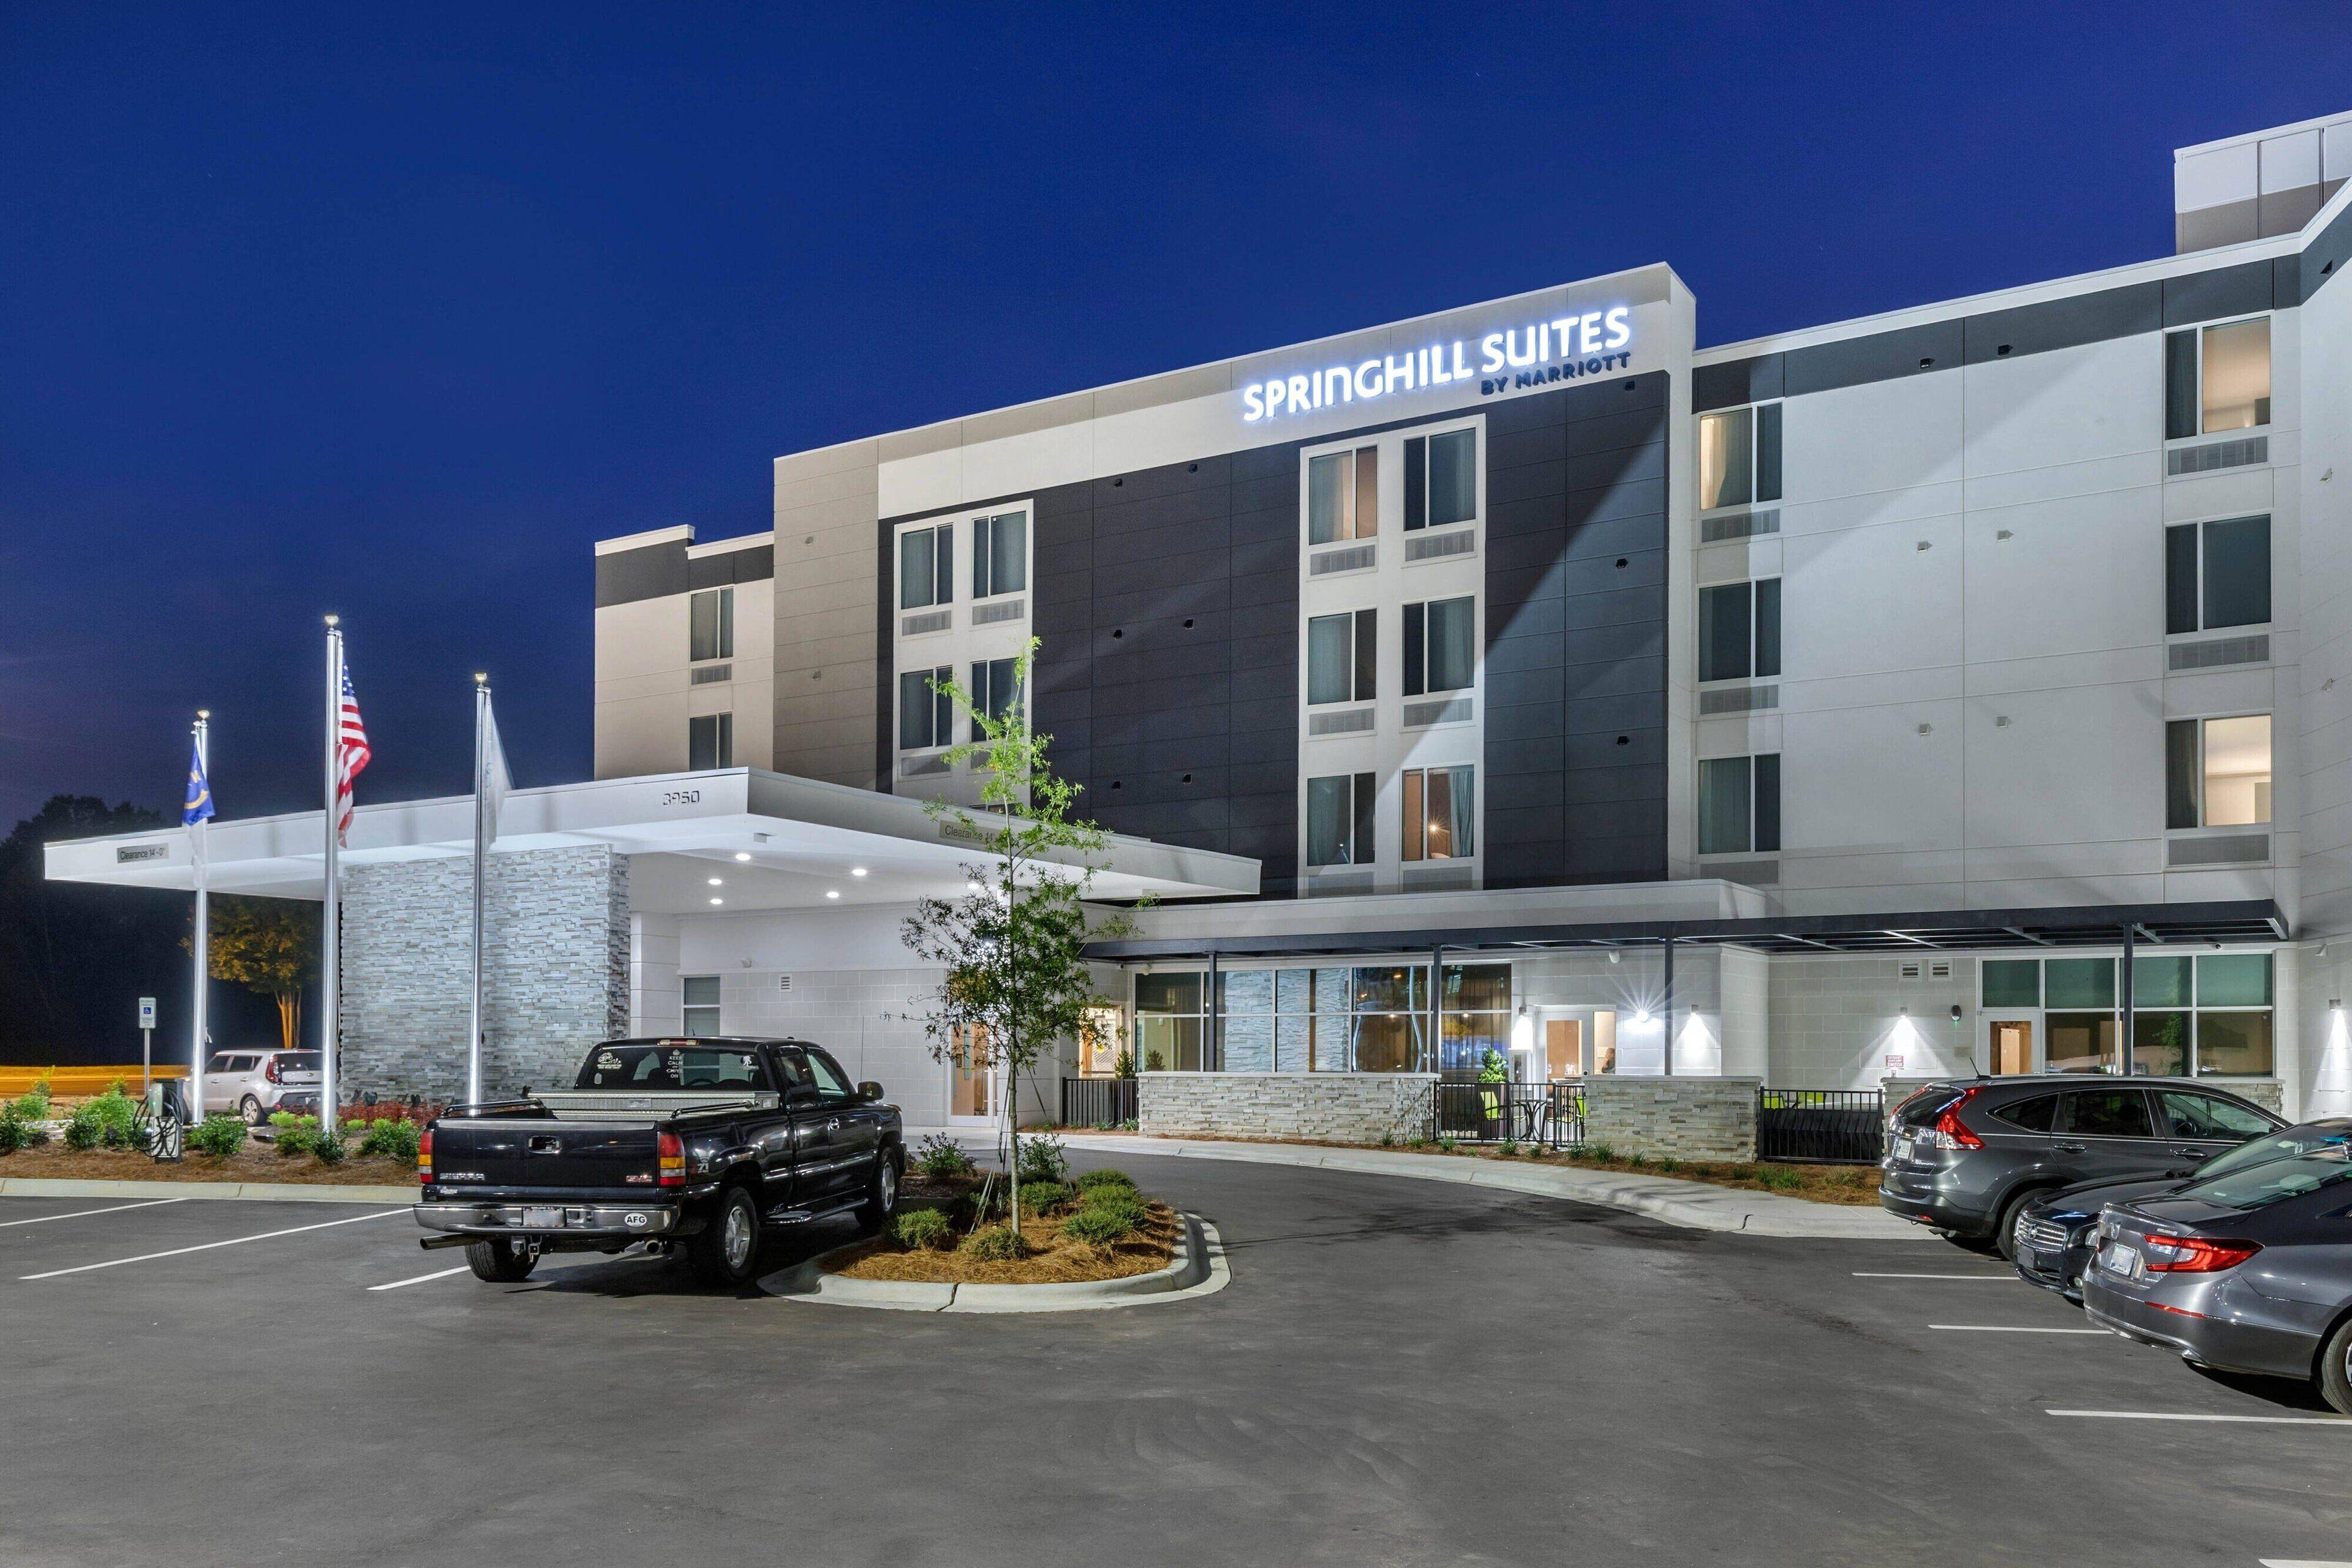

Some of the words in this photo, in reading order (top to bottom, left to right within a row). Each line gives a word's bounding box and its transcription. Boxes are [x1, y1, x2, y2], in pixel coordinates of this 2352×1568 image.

[1243, 341, 1474, 422] SPRINGHILL
[1481, 307, 1631, 374] SUITES
[1481, 377, 1509, 396] BY
[1515, 351, 1631, 389] MARRIOTT
[945, 825, 983, 840] Clearae
[120, 851, 148, 860] Clearance
